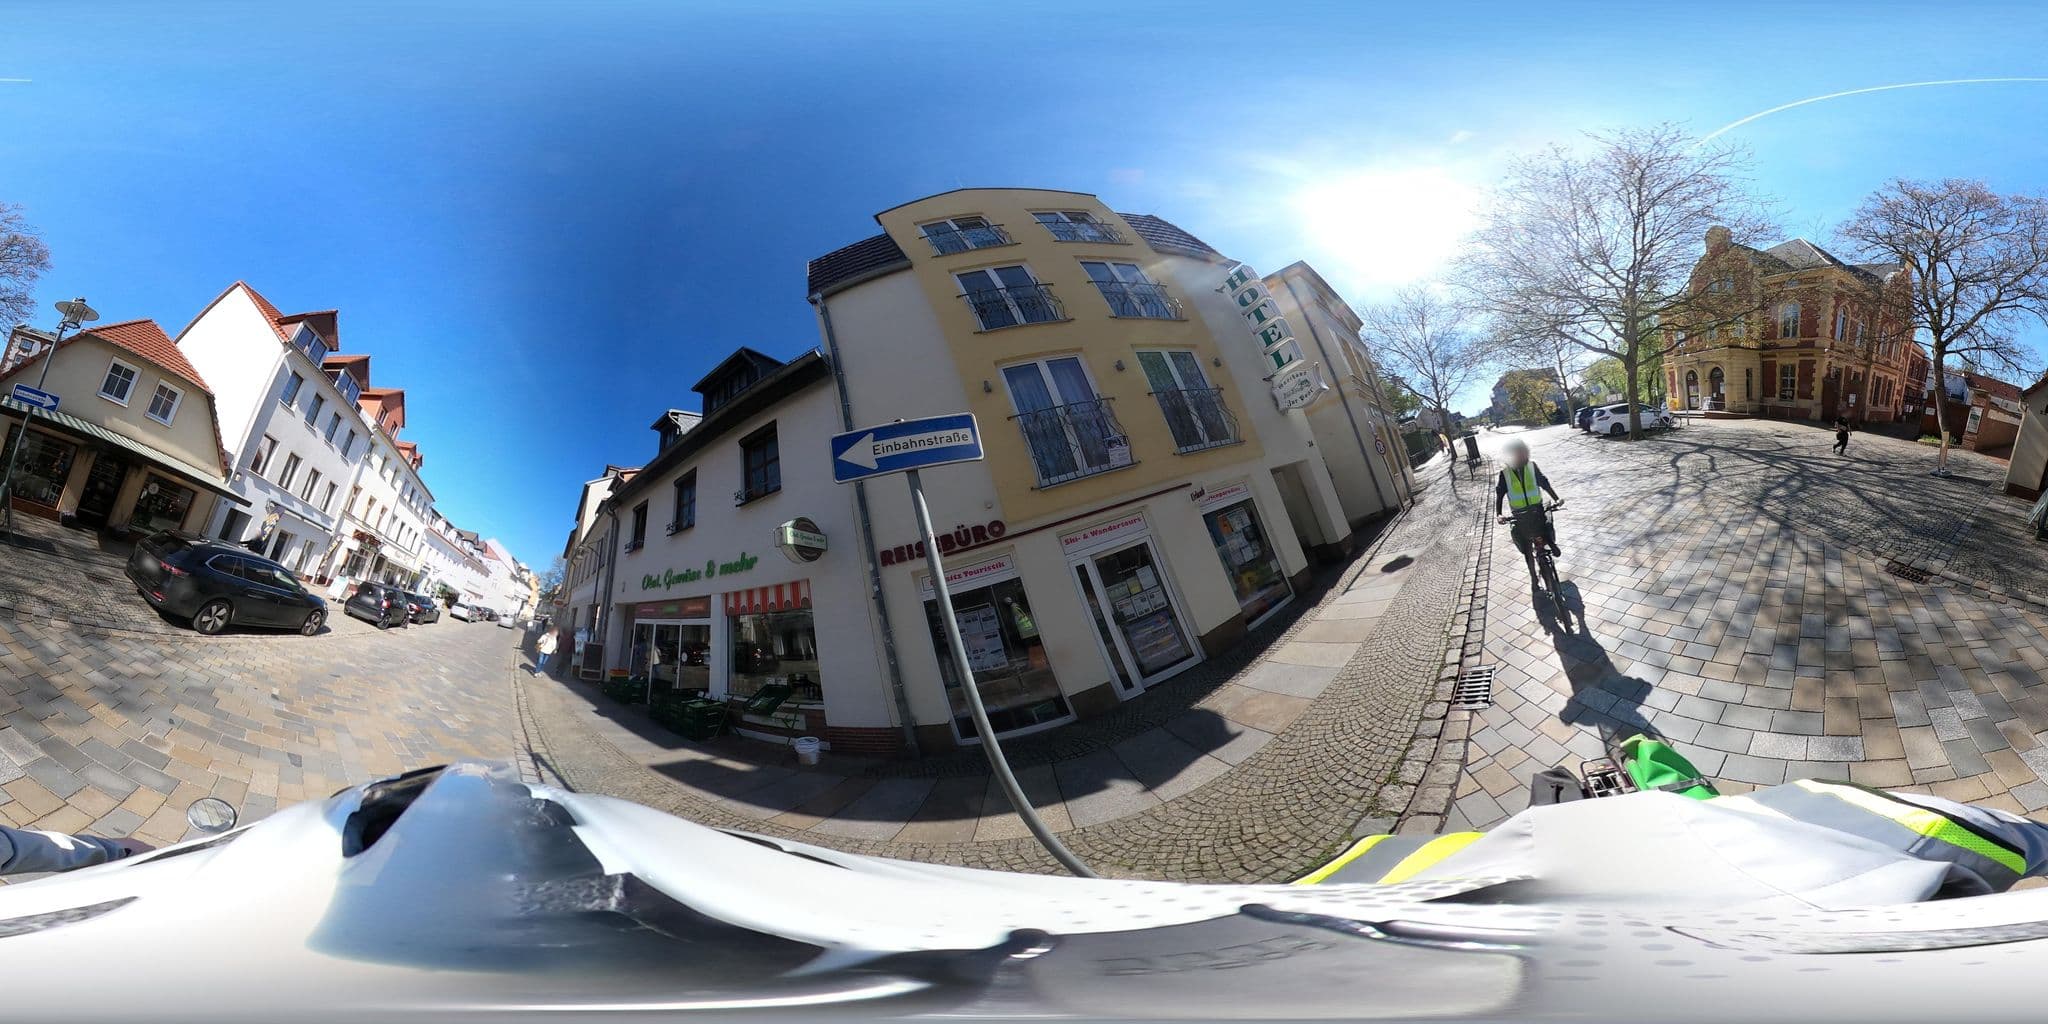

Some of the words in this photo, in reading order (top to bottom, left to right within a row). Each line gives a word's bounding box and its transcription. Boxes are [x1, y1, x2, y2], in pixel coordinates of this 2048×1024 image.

[1225, 269, 1293, 370] HOTEL
[873, 432, 969, 456] Einbahnstraße
[719, 552, 758, 576] mehr
[963, 560, 1006, 578] Touristik
